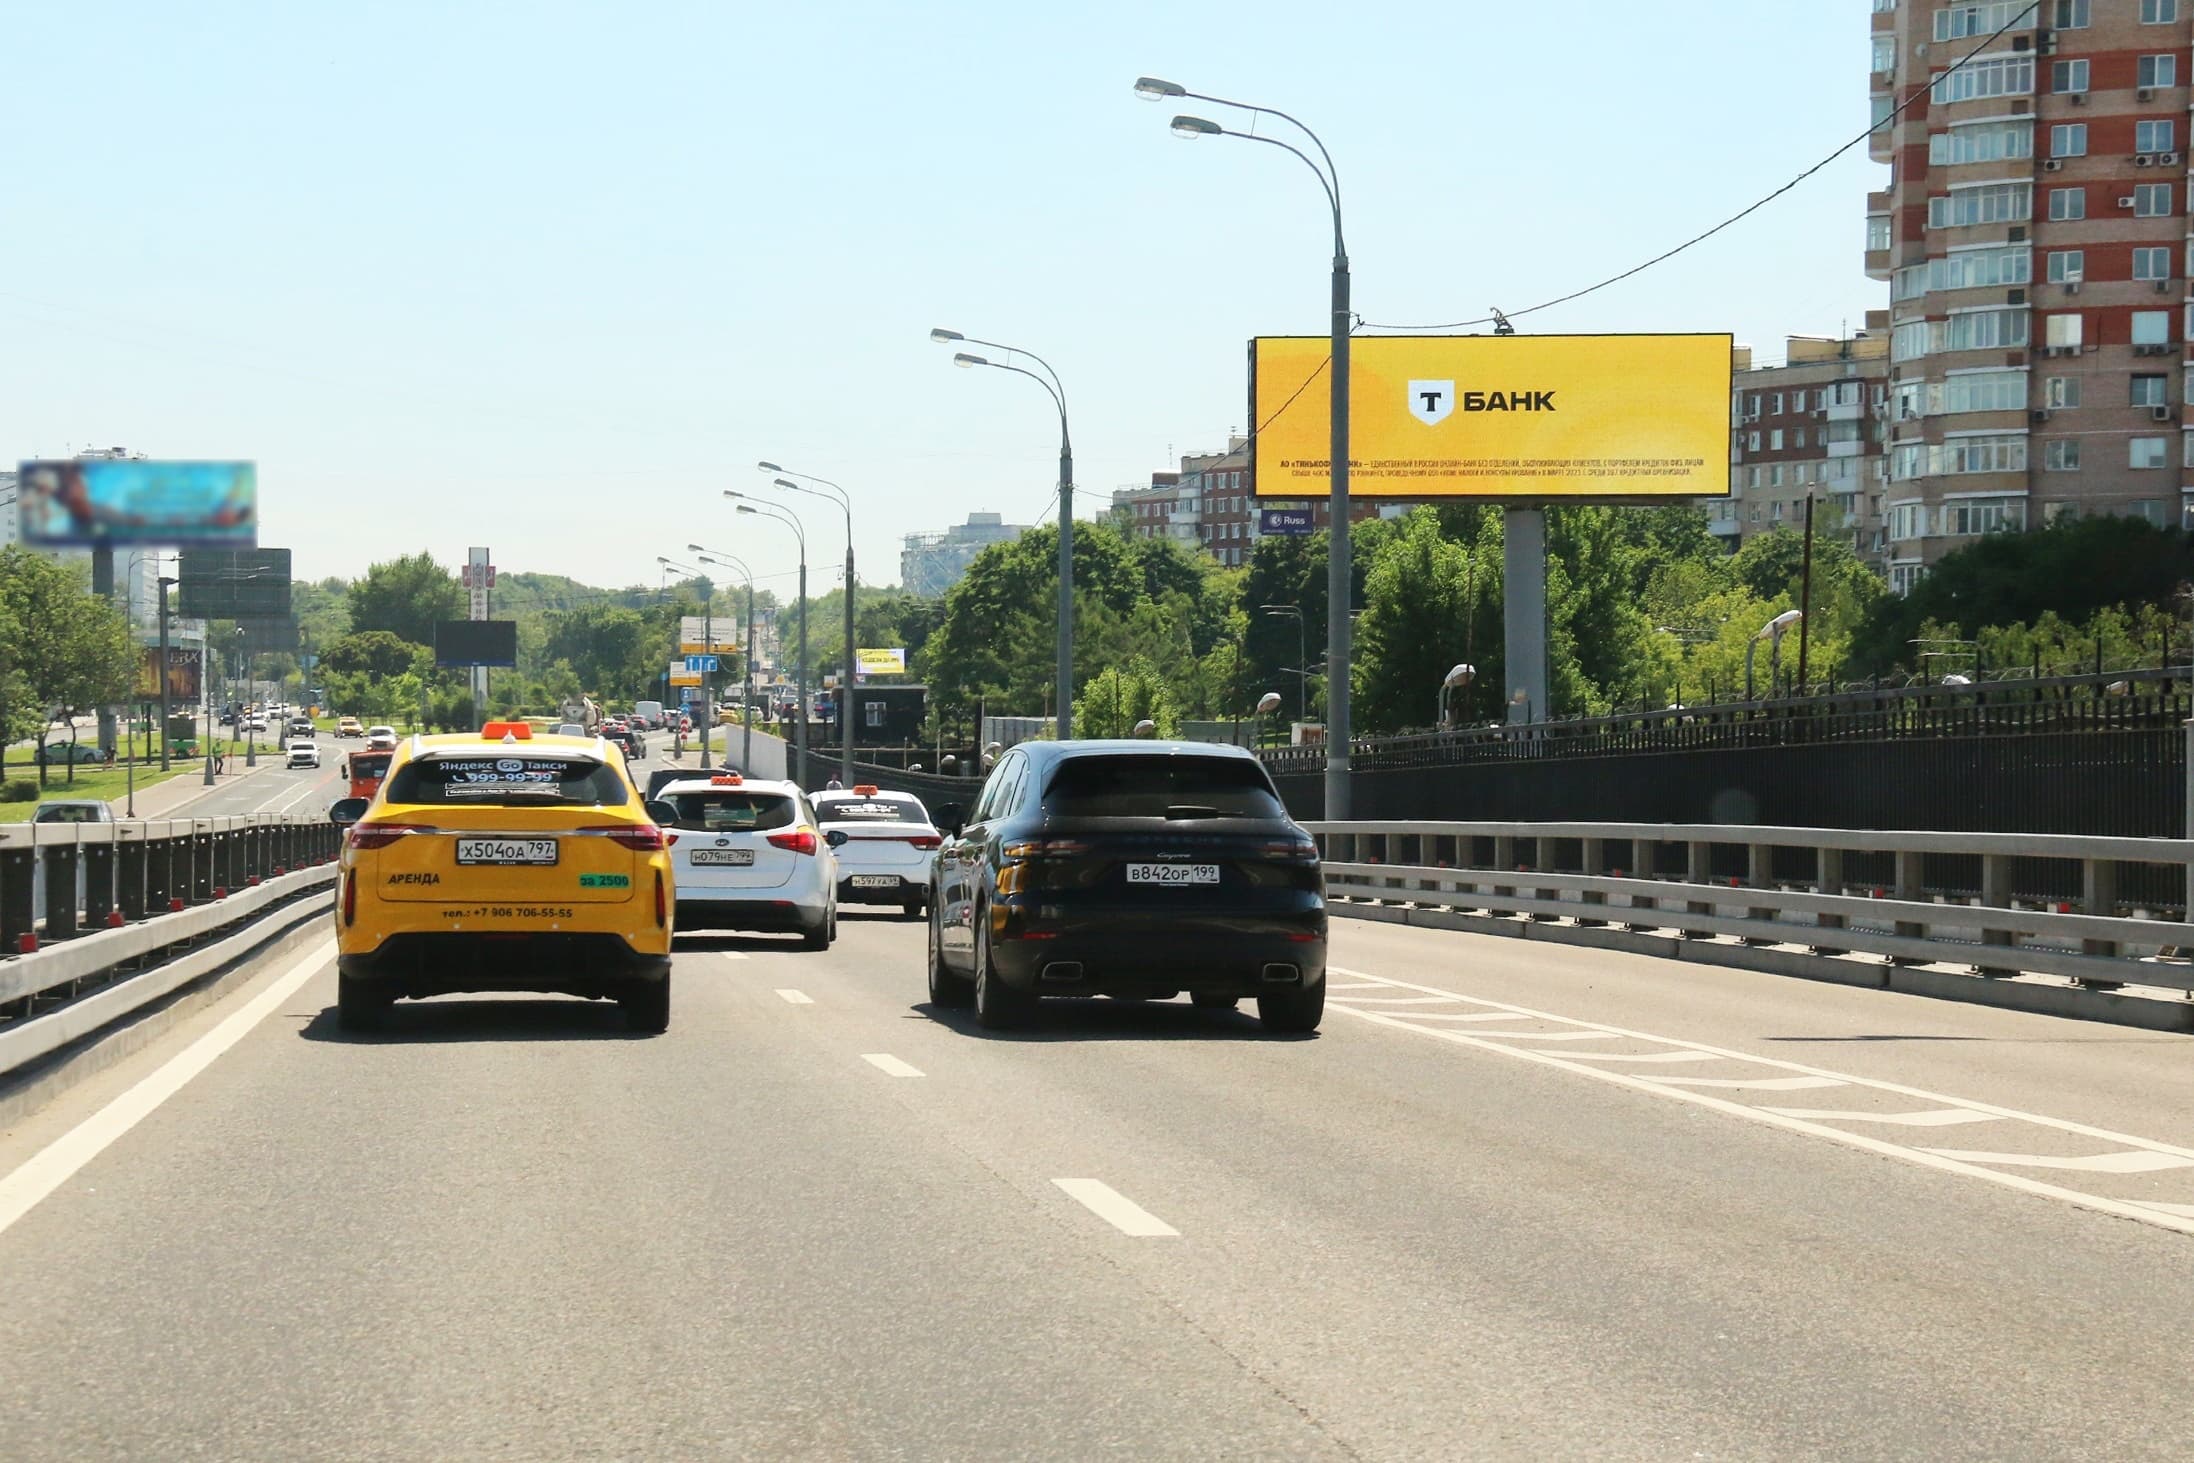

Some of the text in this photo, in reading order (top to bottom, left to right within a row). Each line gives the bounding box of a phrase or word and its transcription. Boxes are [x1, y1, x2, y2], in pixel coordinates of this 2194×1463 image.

[1420, 391, 1557, 412] Т БАНК
[1280, 460, 1290, 468] АО
[1283, 516, 1306, 525] Russ
[439, 761, 494, 771] Яндекс
[526, 761, 568, 770] Такси
[467, 772, 553, 783] 999-99-99
[529, 842, 552, 854] 797
[1193, 865, 1216, 877] 199
[387, 873, 441, 887] АРЕНДА
[599, 875, 630, 887] 2500
[474, 908, 488, 917] +7
[492, 908, 513, 918] 906
[515, 908, 573, 918] 706-55-55
